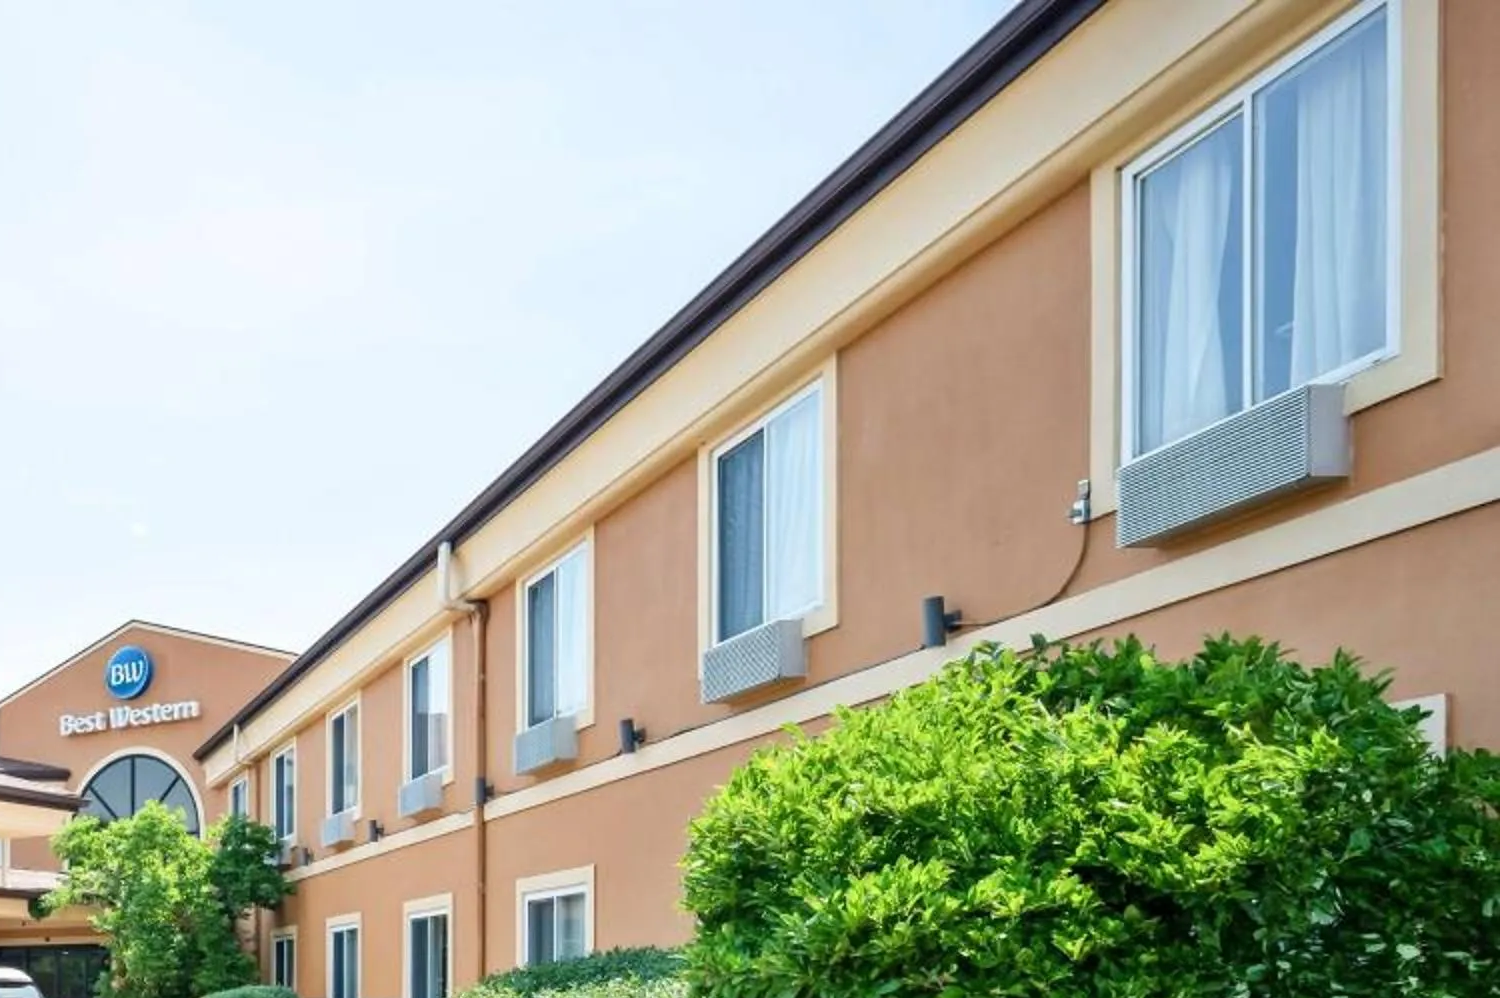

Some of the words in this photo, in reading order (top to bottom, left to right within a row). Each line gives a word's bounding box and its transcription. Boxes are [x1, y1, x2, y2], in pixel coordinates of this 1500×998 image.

[111, 661, 143, 685] BW
[60, 712, 106, 736] Best
[109, 701, 199, 729] Western
